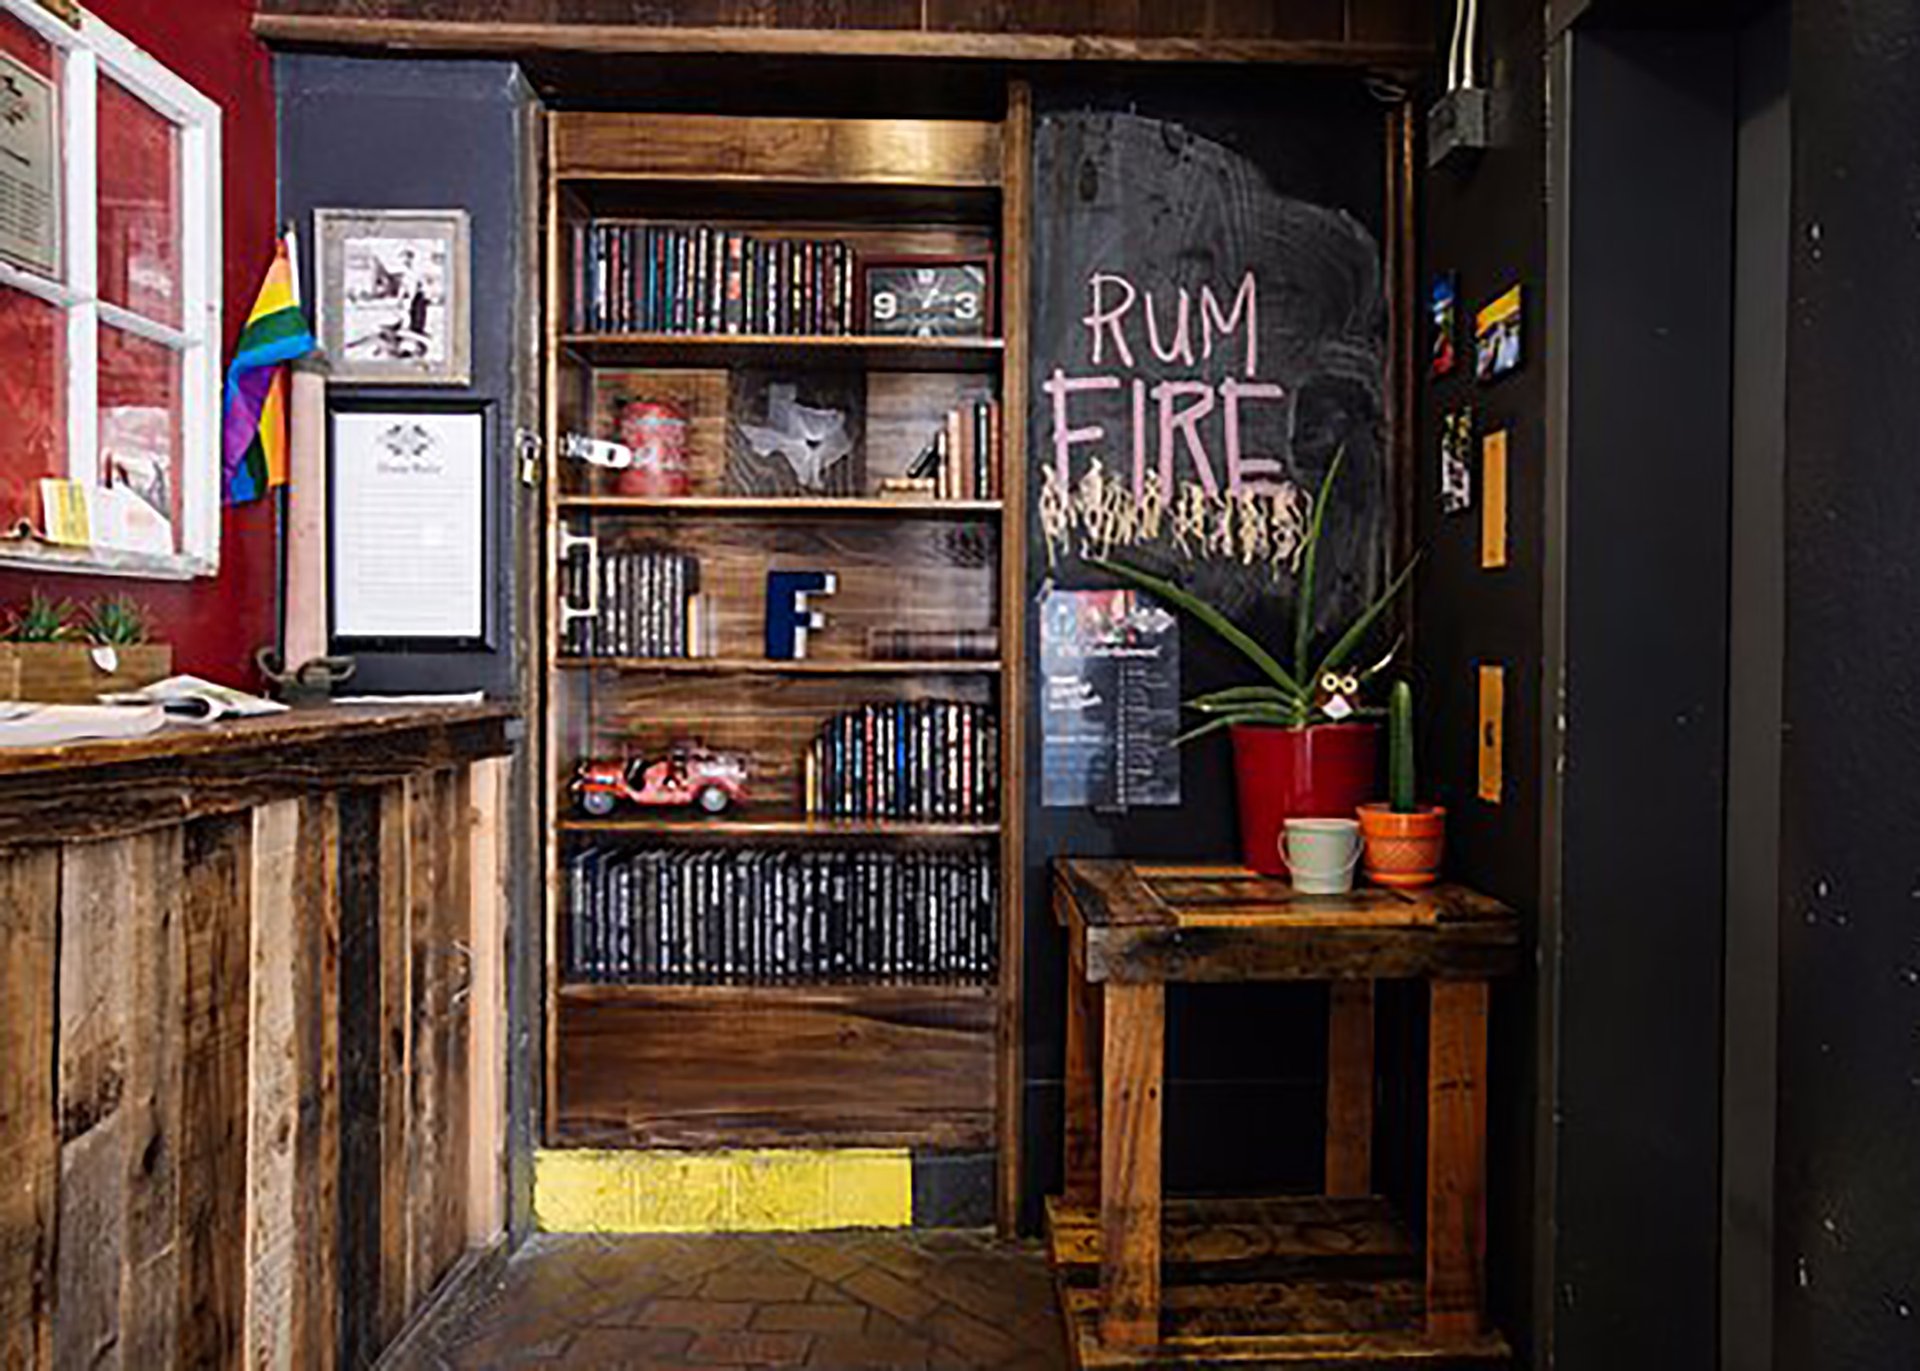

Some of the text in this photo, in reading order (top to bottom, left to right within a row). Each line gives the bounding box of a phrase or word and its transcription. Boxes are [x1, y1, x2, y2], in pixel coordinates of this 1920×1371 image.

[873, 291, 978, 320] 9 3
[1083, 271, 1257, 377] RUM
[1042, 368, 1296, 507] FIRE
[765, 570, 838, 660] F
